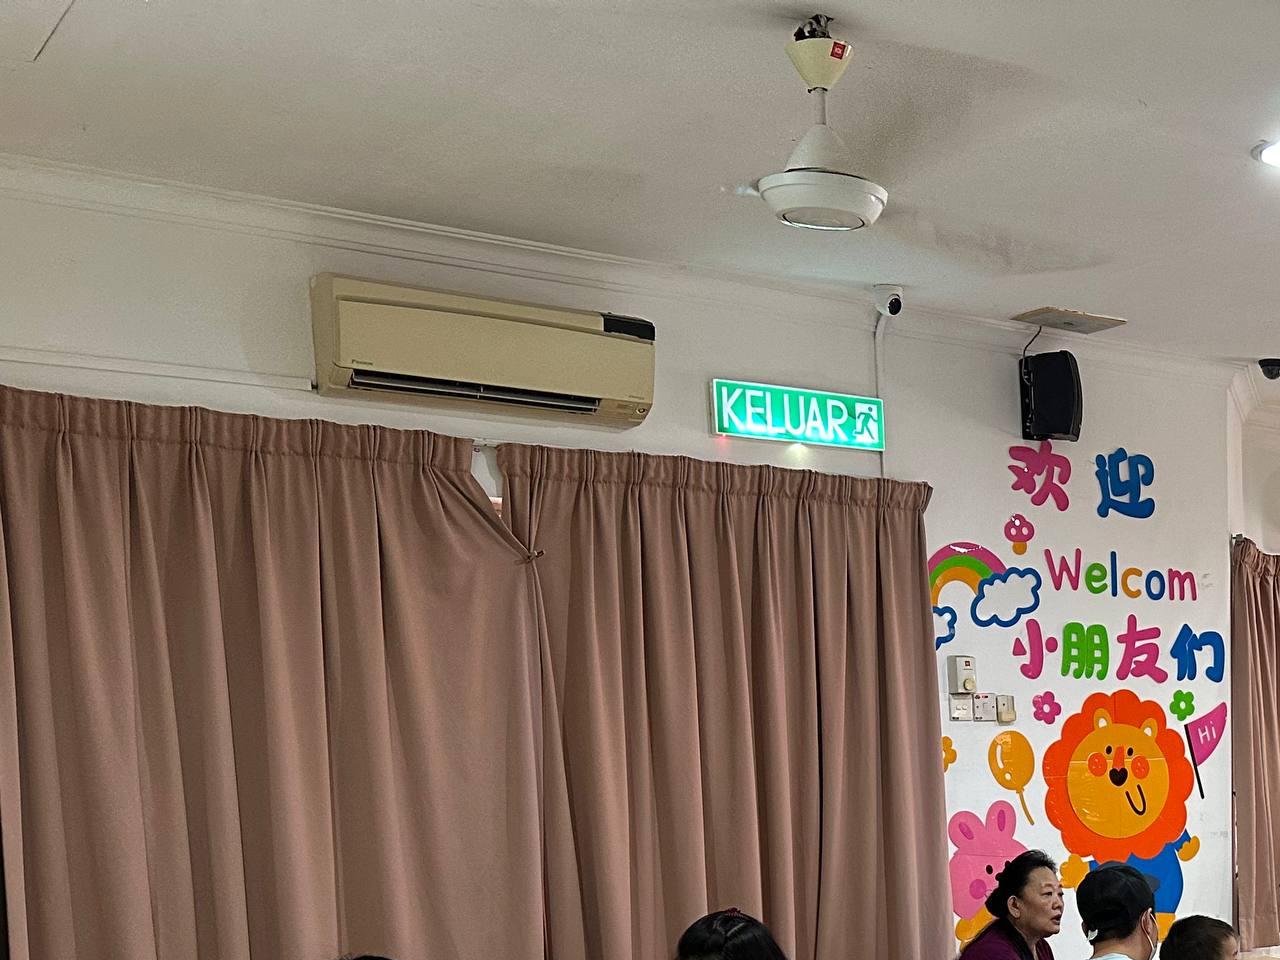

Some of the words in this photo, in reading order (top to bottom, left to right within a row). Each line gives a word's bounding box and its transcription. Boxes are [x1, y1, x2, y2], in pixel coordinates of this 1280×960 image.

[721, 386, 848, 441] KELUAR
[1008, 439, 1156, 519] 欢迎
[1045, 549, 1197, 601] Welcom
[1013, 615, 1225, 684] 小朋友们
[1197, 720, 1217, 745] Hi
